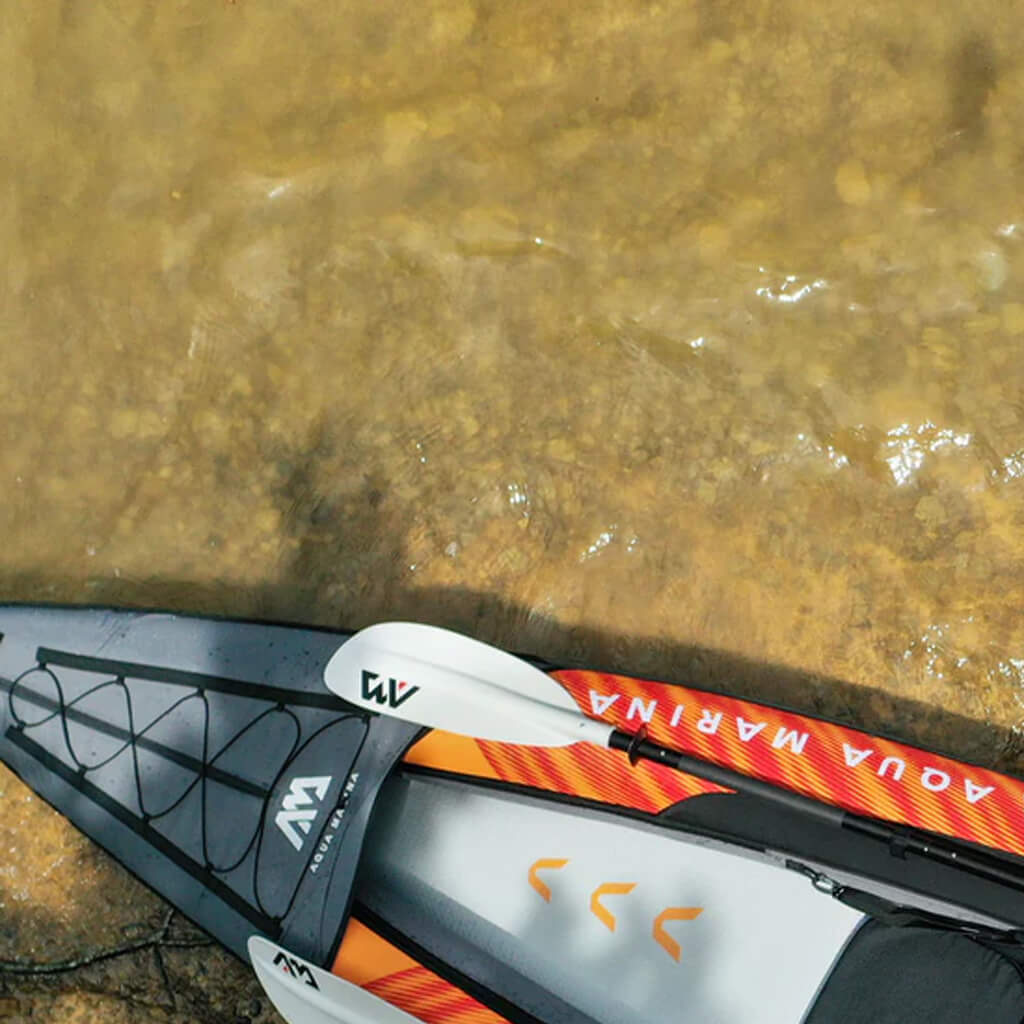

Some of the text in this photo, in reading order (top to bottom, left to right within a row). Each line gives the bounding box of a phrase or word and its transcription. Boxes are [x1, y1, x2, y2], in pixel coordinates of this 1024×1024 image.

[588, 689, 996, 804] AQUA MARINA
[310, 772, 359, 873] AQUA MANA
